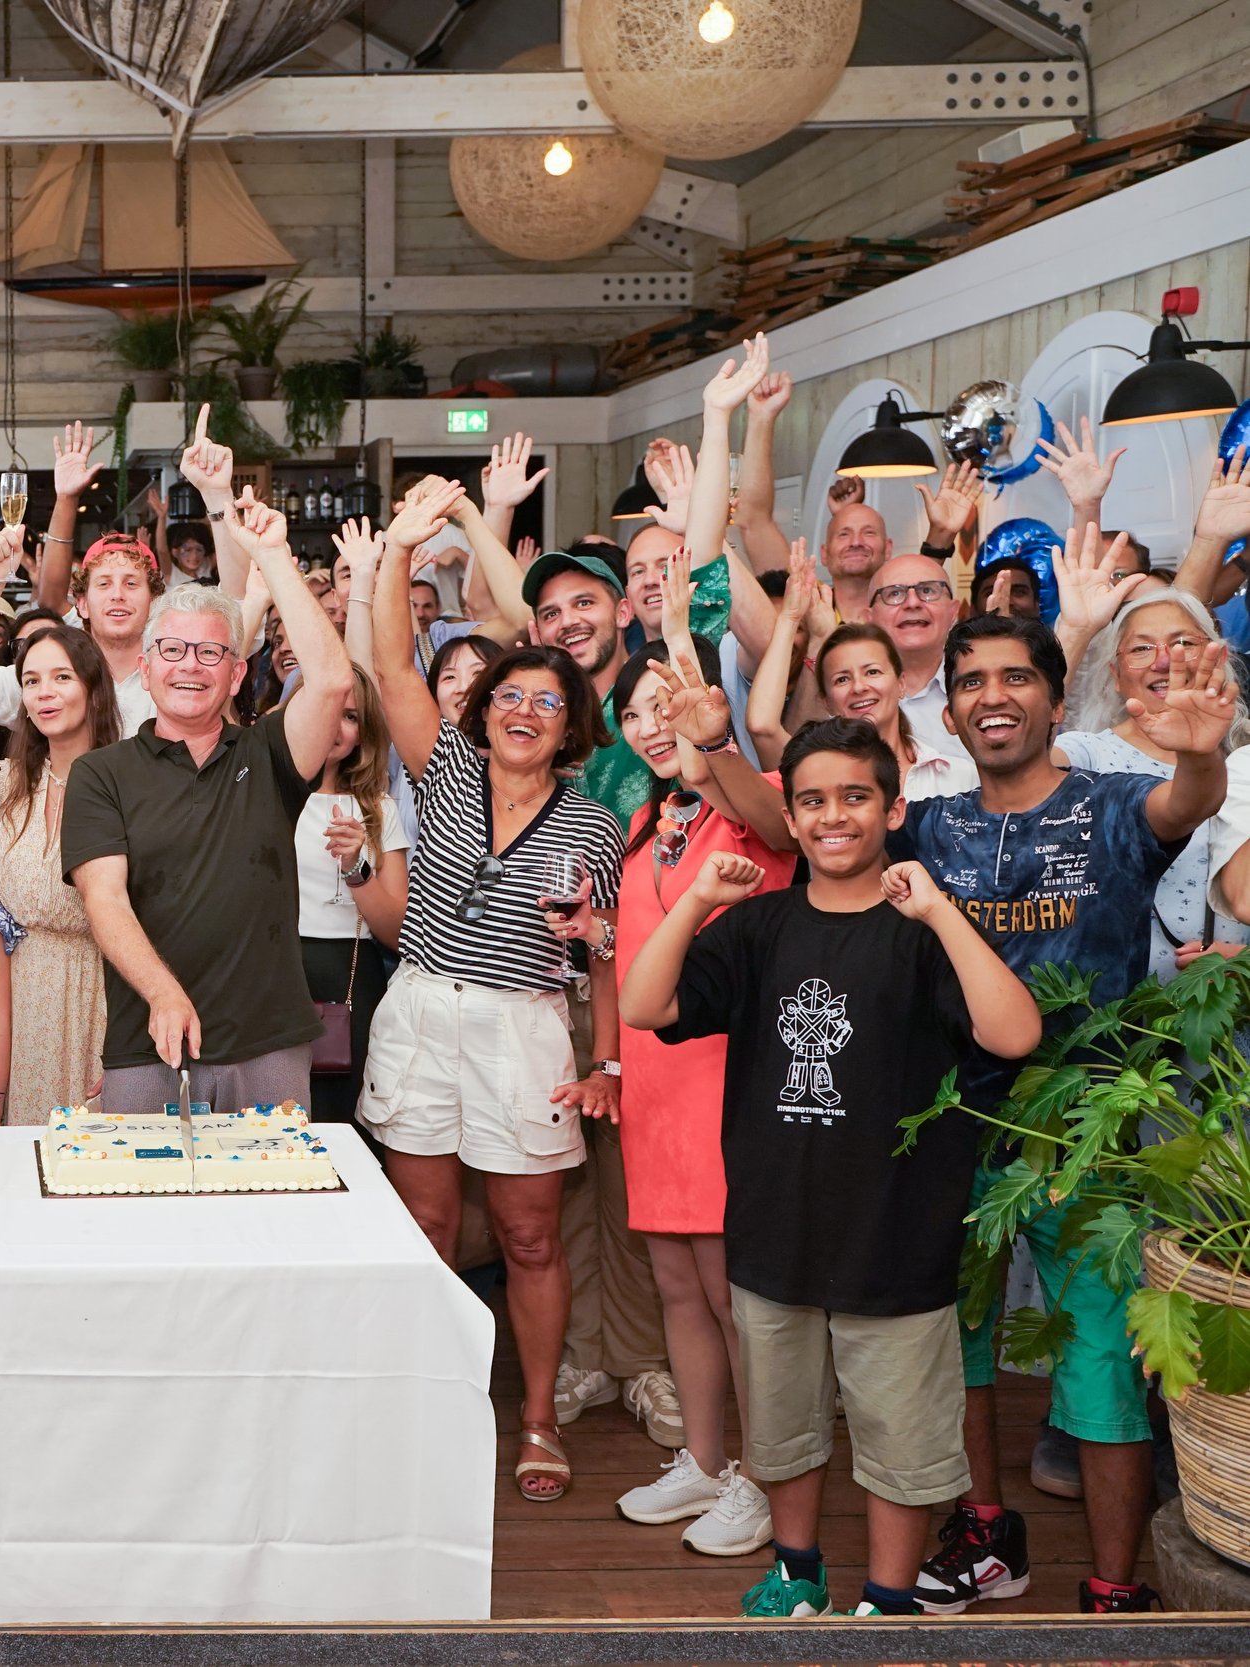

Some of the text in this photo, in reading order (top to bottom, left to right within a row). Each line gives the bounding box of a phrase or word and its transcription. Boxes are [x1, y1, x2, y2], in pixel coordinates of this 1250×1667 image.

[1043, 876, 1084, 887] MIAMI BEAC
[940, 890, 1077, 932] STERDAM
